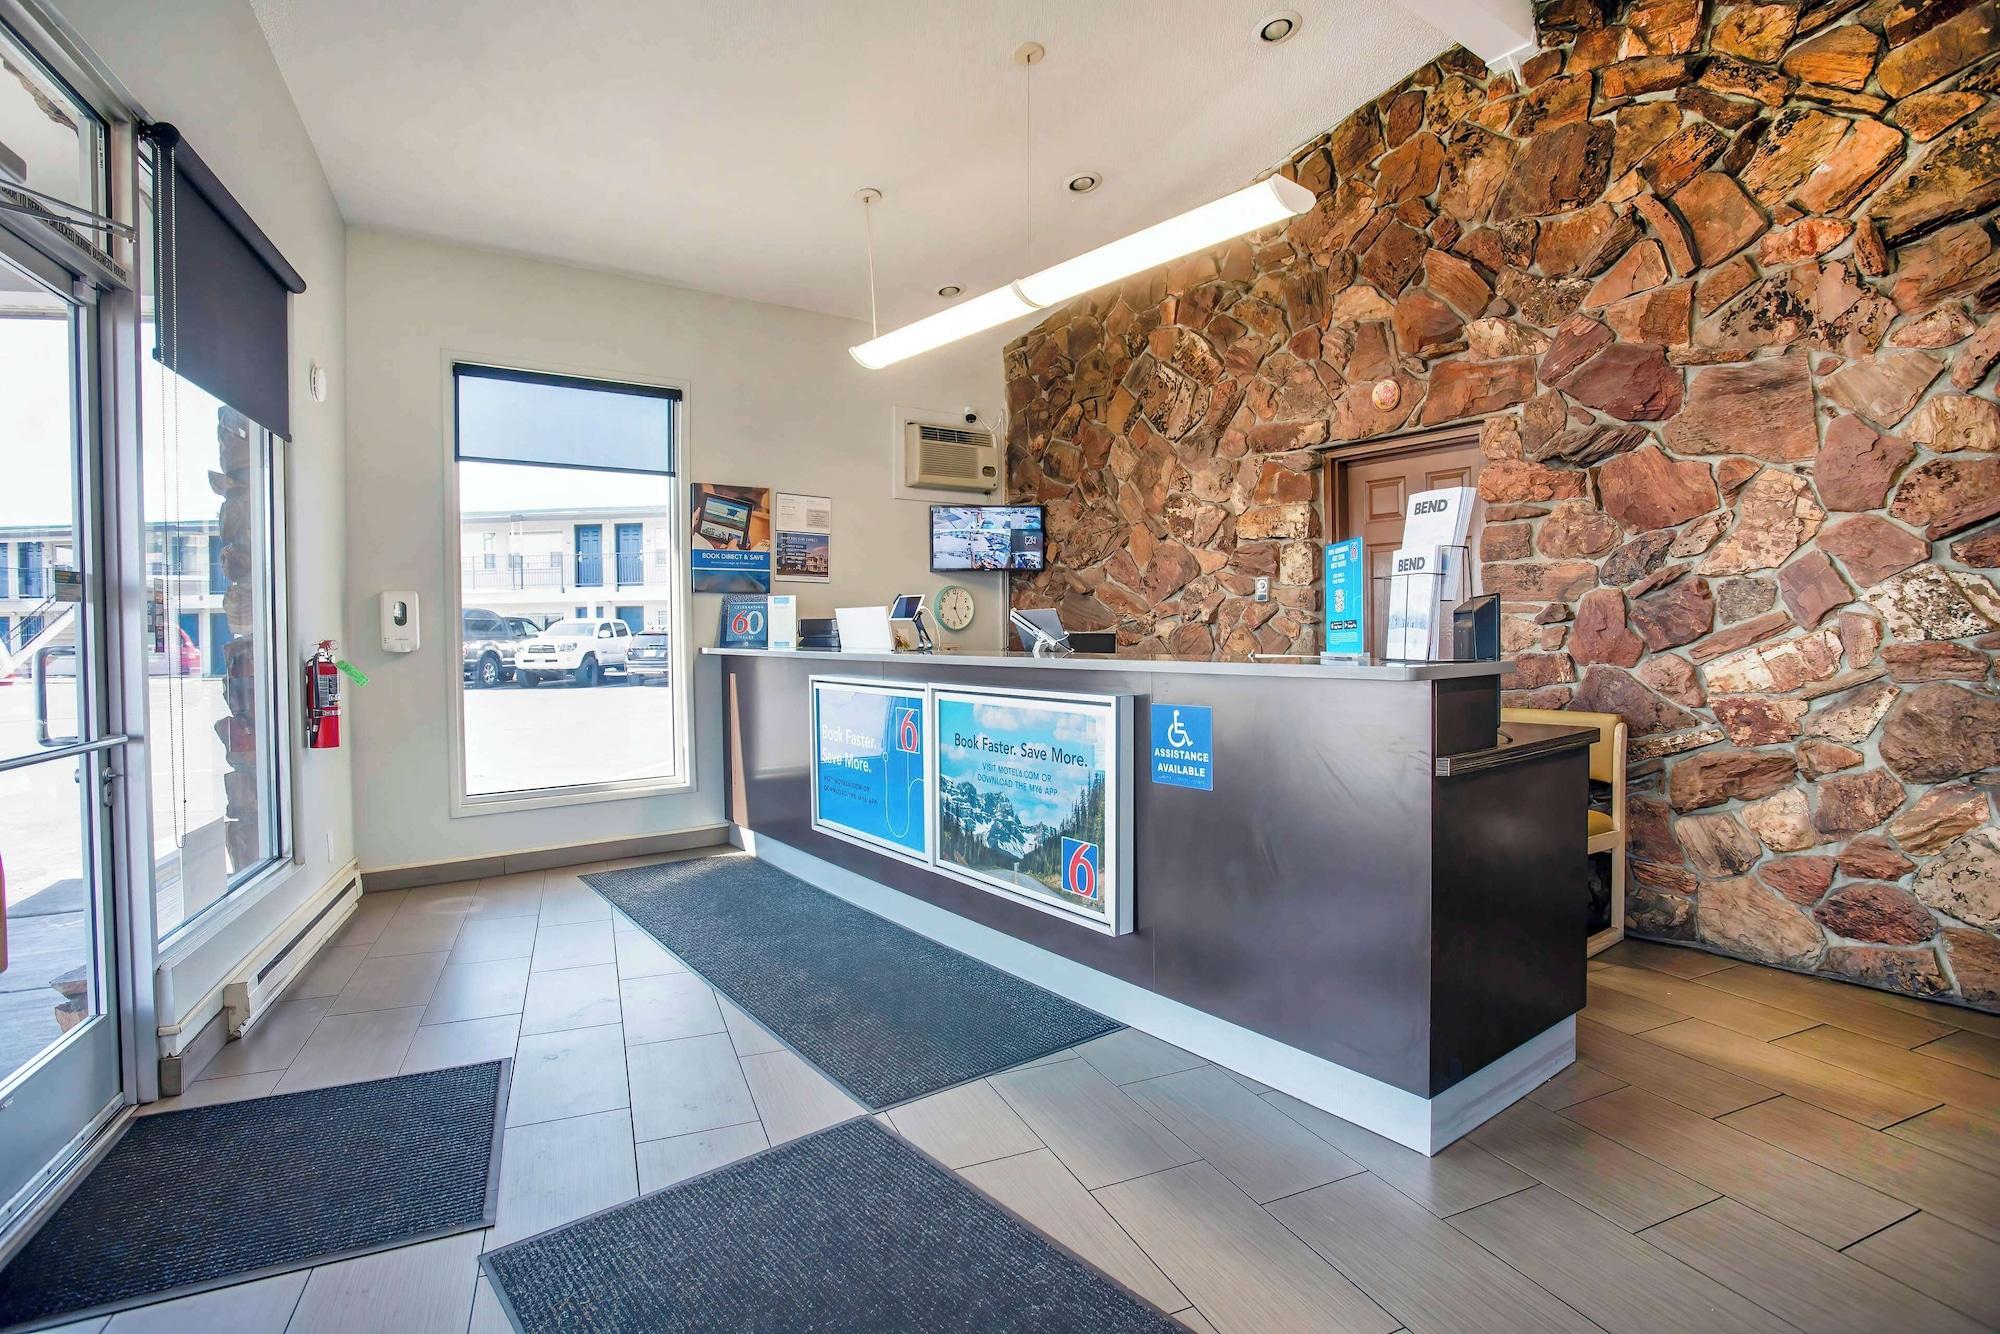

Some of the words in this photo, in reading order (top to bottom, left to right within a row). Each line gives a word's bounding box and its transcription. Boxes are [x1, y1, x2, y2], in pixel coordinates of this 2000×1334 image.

[1413, 498, 1448, 516] BEND
[701, 552, 720, 560] BOOK
[721, 553, 743, 561] DIRECT
[1397, 556, 1426, 573] BEND
[731, 609, 764, 635] 60
[822, 725, 844, 743] Book
[845, 729, 877, 750] Faster.
[900, 708, 918, 752] 6
[822, 748, 843, 767] Save
[845, 752, 872, 773] More.
[954, 732, 979, 750] Book
[982, 737, 1017, 756] Faster.
[1020, 742, 1047, 762] Save
[1051, 747, 1088, 768] More.
[1154, 747, 1209, 763] ASSISTANCE
[982, 762, 996, 772] VISIT
[998, 766, 1040, 780] MOTEL6.COM
[1041, 773, 1052, 783] OR
[1157, 762, 1206, 778] AVAILABLE
[977, 773, 1013, 788] DOWNLOAD
[1015, 781, 1028, 791] THE
[1029, 783, 1043, 794] MY6
[1045, 787, 1058, 797] APP
[1068, 842, 1096, 898] 6
